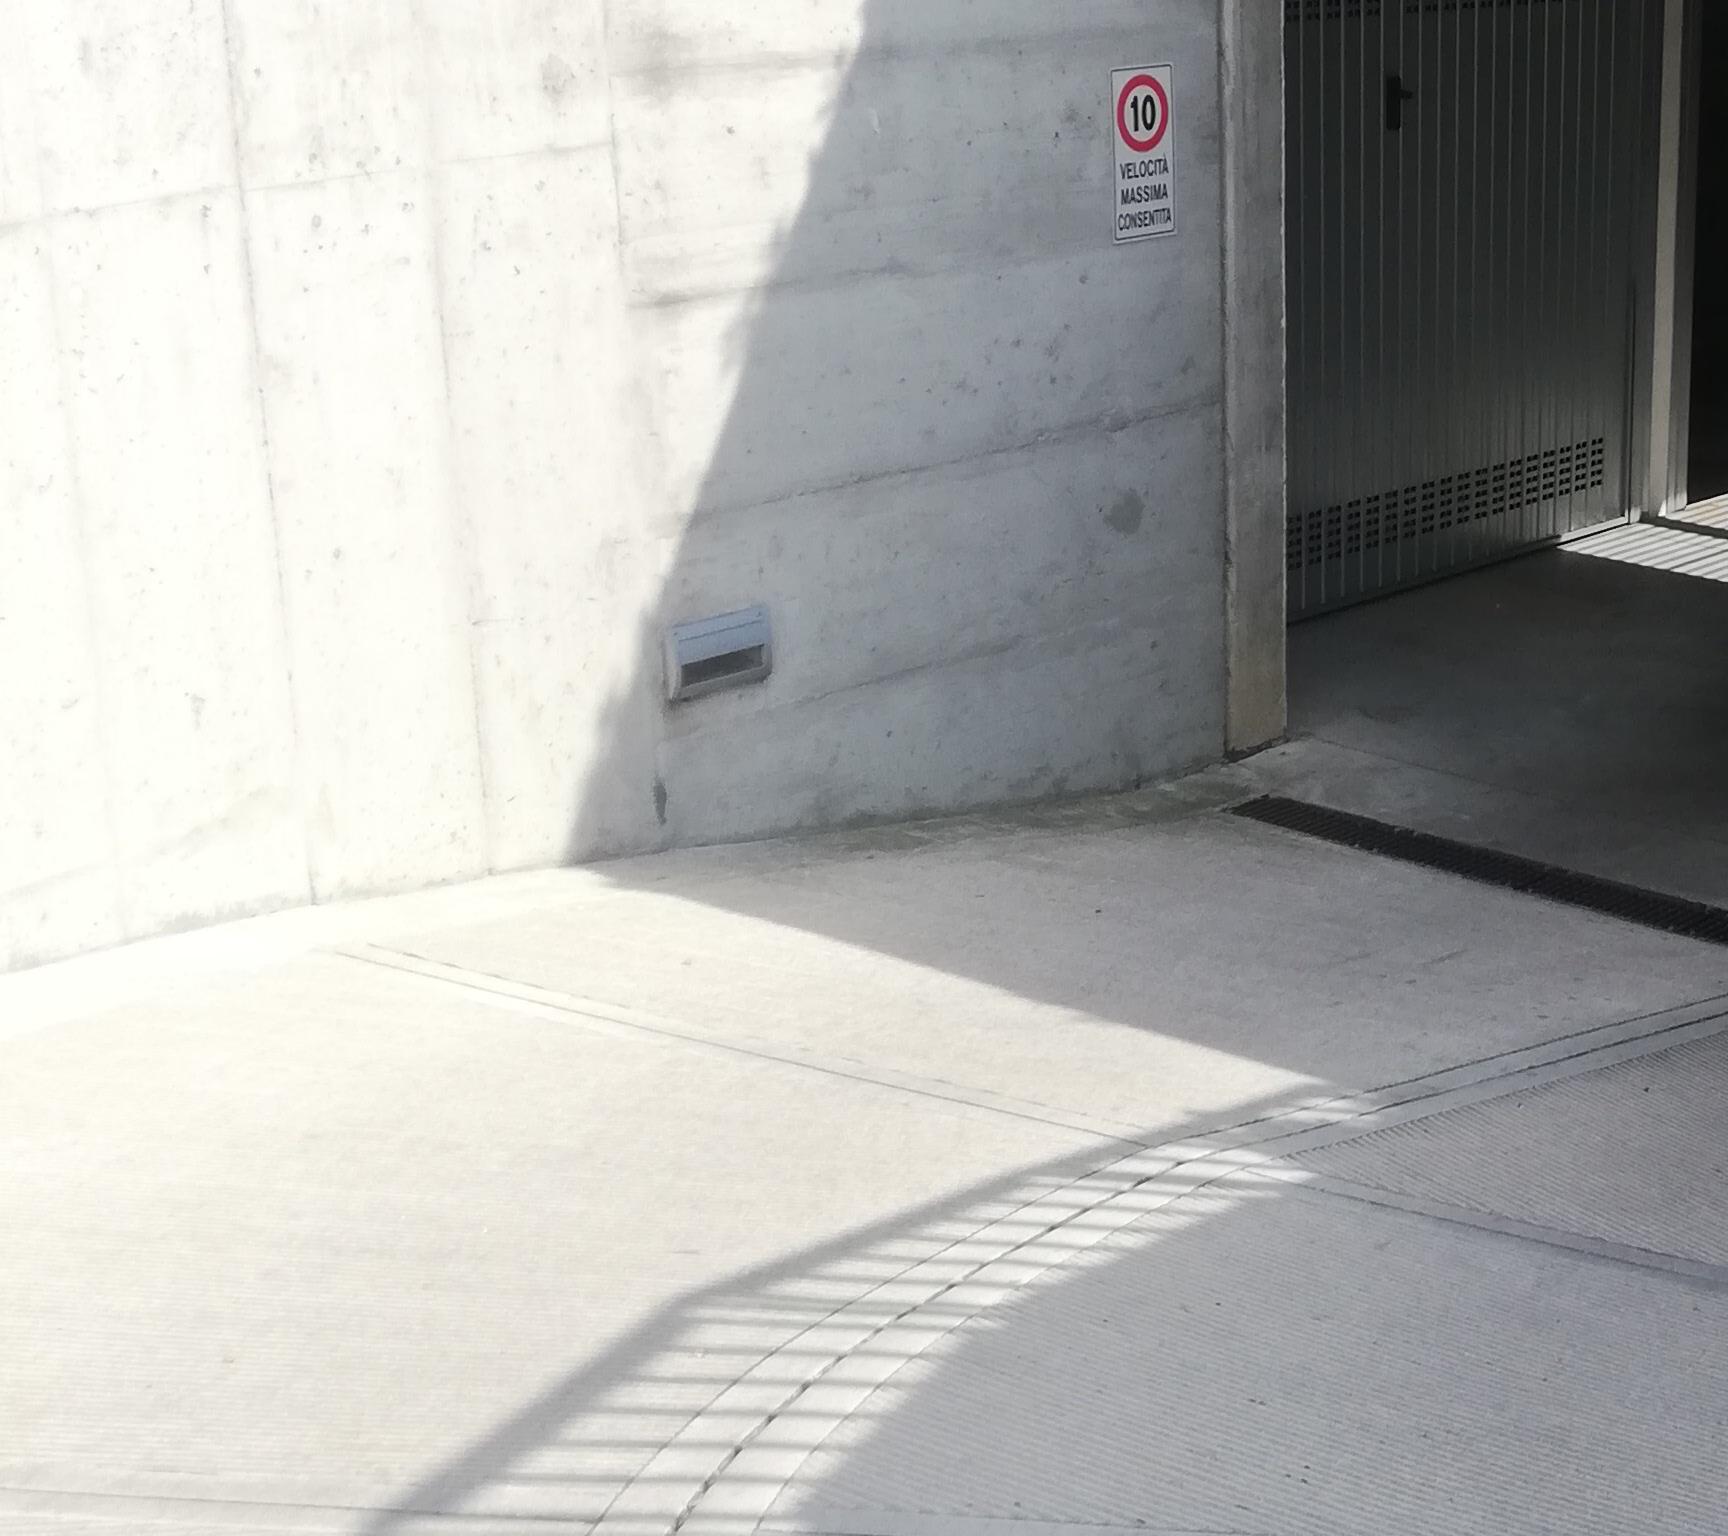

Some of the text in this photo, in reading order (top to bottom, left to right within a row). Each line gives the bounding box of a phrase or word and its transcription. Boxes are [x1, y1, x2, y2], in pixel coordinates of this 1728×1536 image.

[1130, 95, 1156, 132] 10
[1120, 183, 1168, 205] MASSIMA
[1118, 207, 1171, 231] CONSENTITA
